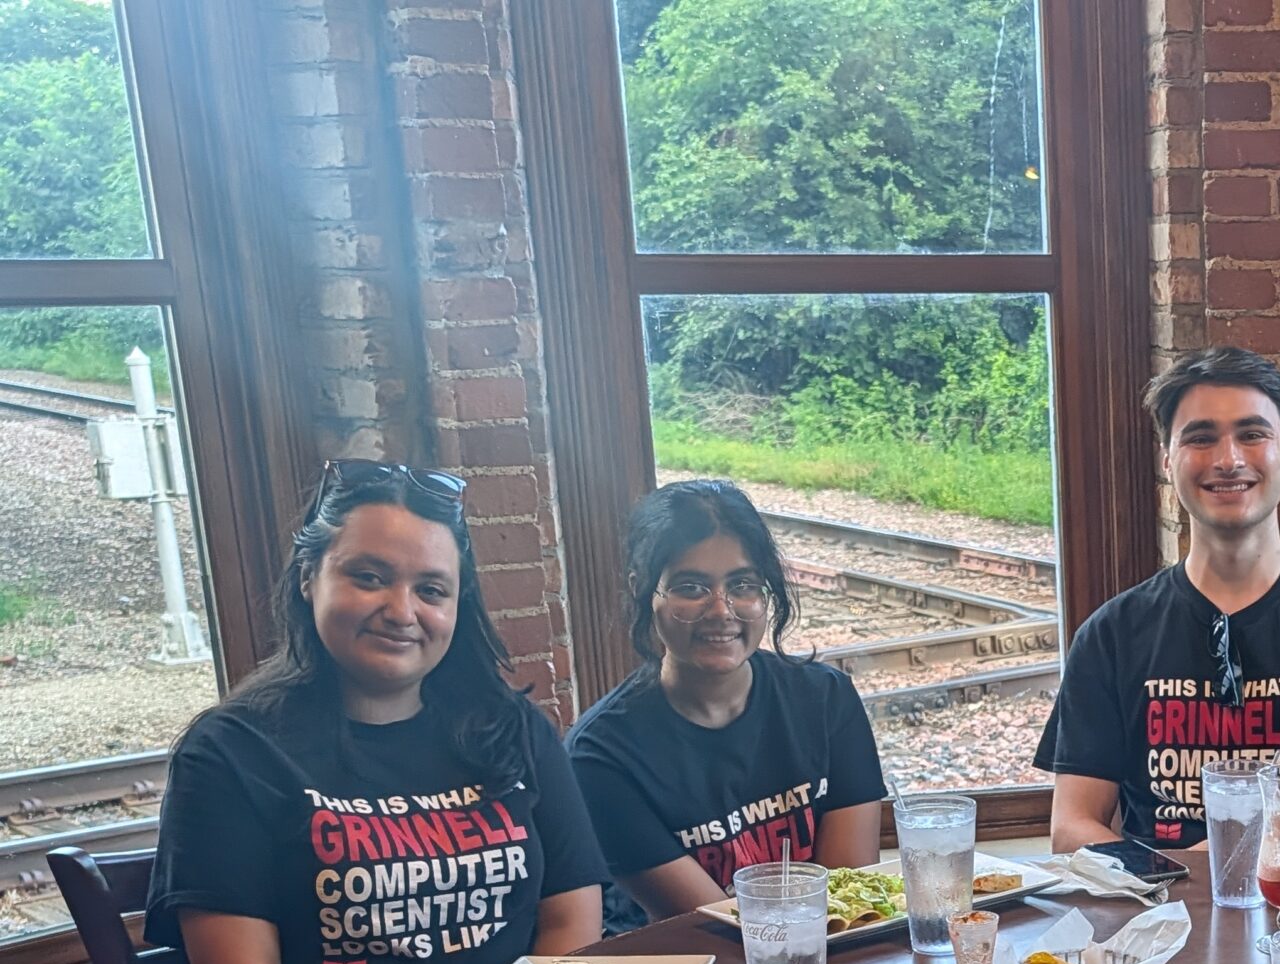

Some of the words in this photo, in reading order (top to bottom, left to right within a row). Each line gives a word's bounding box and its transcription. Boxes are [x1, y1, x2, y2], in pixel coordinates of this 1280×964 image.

[1144, 679, 1197, 697] THIS
[304, 789, 372, 814] THIS
[377, 796, 409, 815] IS
[411, 784, 483, 810] WHA
[674, 820, 726, 848] HIS
[727, 810, 742, 834] IS
[742, 782, 811, 824] WHAT
[814, 777, 829, 799] A
[310, 800, 528, 865] GRINNELL
[316, 846, 528, 904] COMPUTER
[319, 885, 512, 939] SCIENTIST
[322, 933, 433, 959] LOOKS
